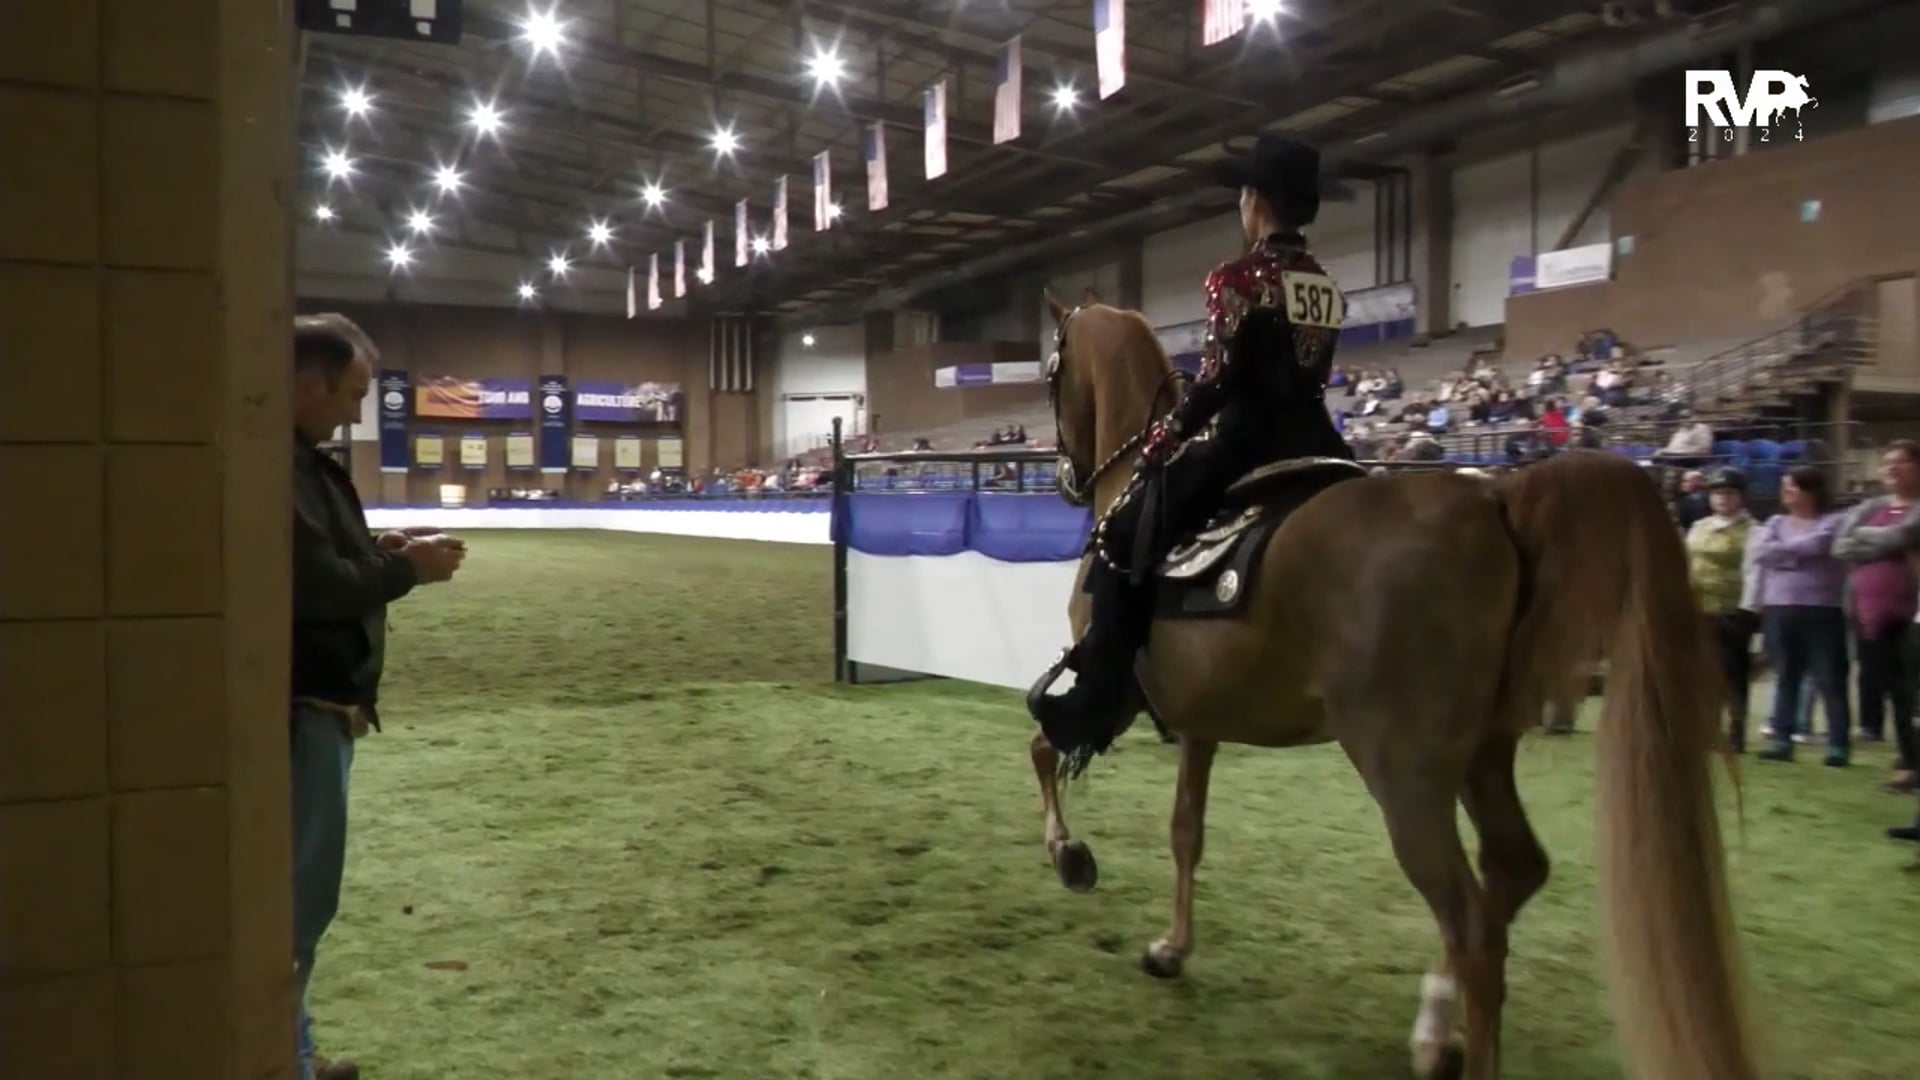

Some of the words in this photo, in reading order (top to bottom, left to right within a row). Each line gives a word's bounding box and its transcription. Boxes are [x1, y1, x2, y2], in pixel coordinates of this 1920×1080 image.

[1294, 283, 1333, 325] 587
[507, 391, 530, 404] AND
[577, 393, 642, 409] AGRICULTURE
